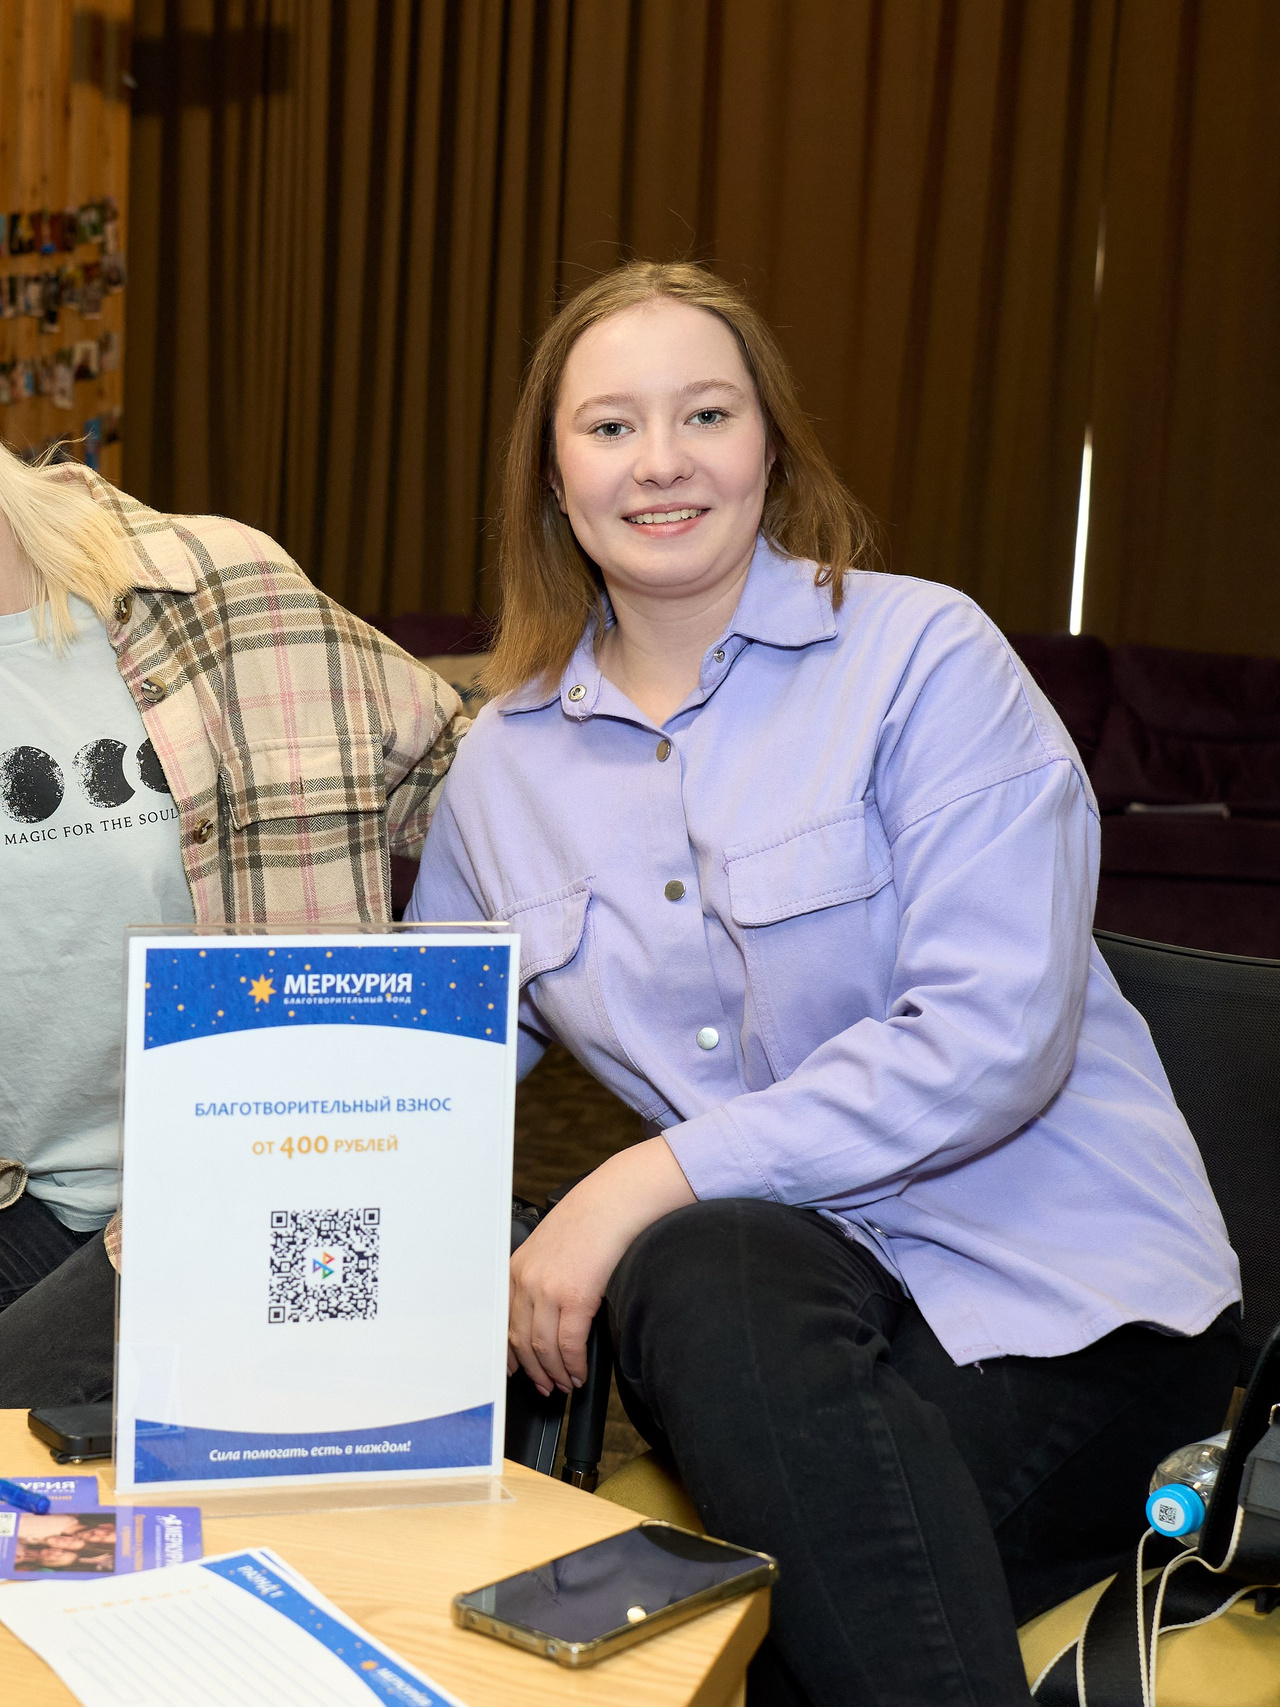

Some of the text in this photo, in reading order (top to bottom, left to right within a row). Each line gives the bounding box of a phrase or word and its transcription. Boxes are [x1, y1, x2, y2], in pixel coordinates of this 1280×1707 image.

[4, 828, 58, 845] MAGIC
[63, 822, 95, 838] FOR
[100, 816, 133, 831] THE
[139, 808, 178, 825] SOUL
[283, 973, 413, 994] МЕРКУРИЯ
[194, 1096, 452, 1117] БЛАГОТВОРИТЕЛЬНЫЙ ВЗНОС
[251, 1135, 399, 1160] ОТ 400 РУБЛЕЙ
[208, 1439, 412, 1463] Сила помогать есть в каждом!
